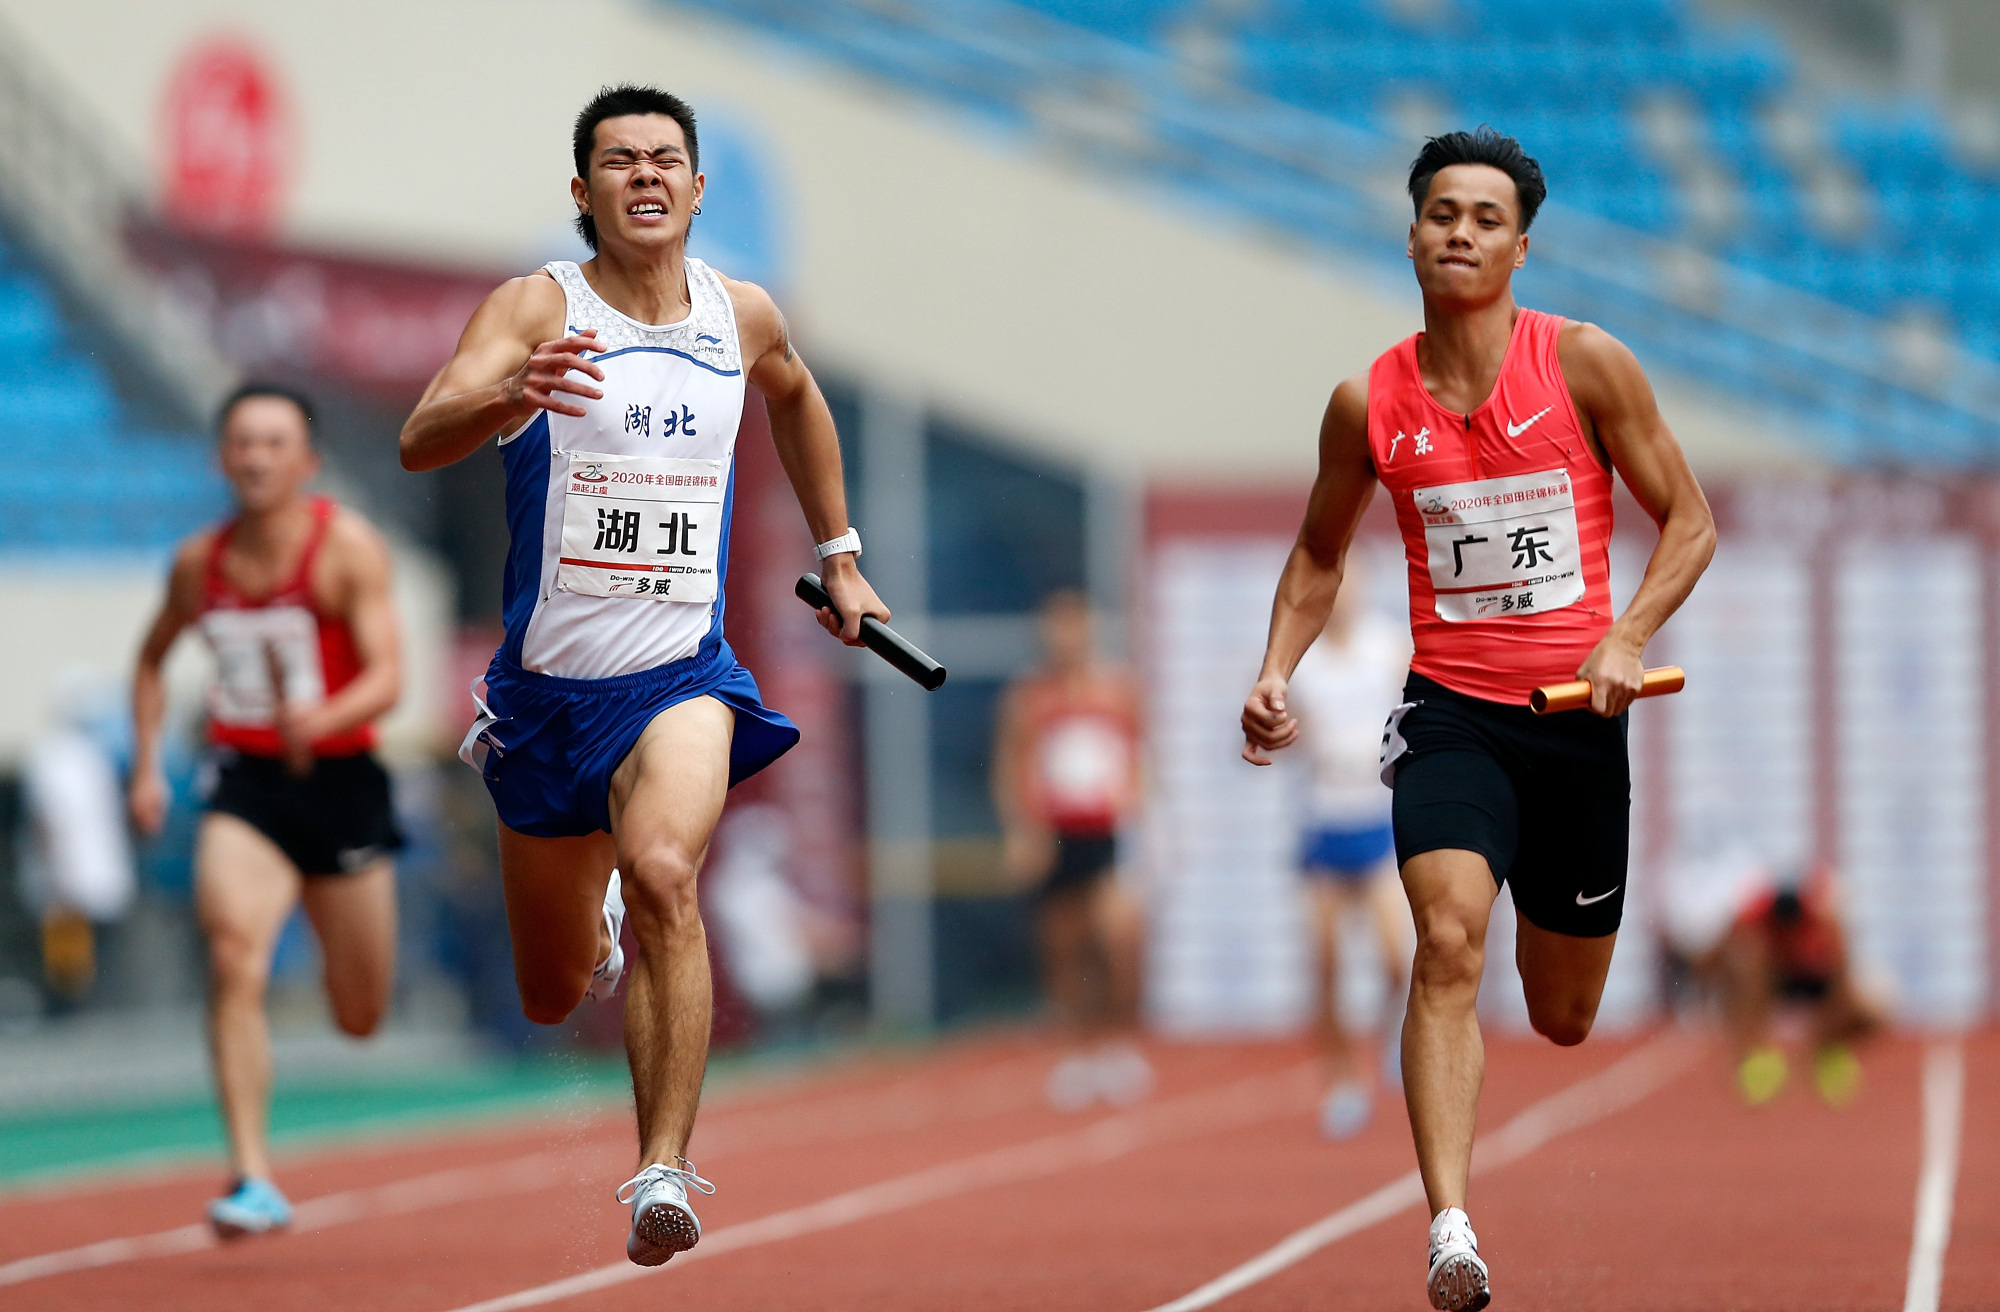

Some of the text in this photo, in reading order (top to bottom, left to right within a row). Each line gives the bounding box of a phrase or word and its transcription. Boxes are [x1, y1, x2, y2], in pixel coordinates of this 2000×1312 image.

[624, 403, 697, 438] 湖北
[1388, 426, 1434, 462] 广东
[611, 471, 718, 488] 2020年全国田径锦标赛
[1451, 482, 1569, 511] 2020年全国田径锦标赛
[593, 508, 697, 556] 湖北
[1452, 526, 1554, 578] 广东
[635, 577, 671, 595] 多威
[1501, 591, 1534, 612] 多威
